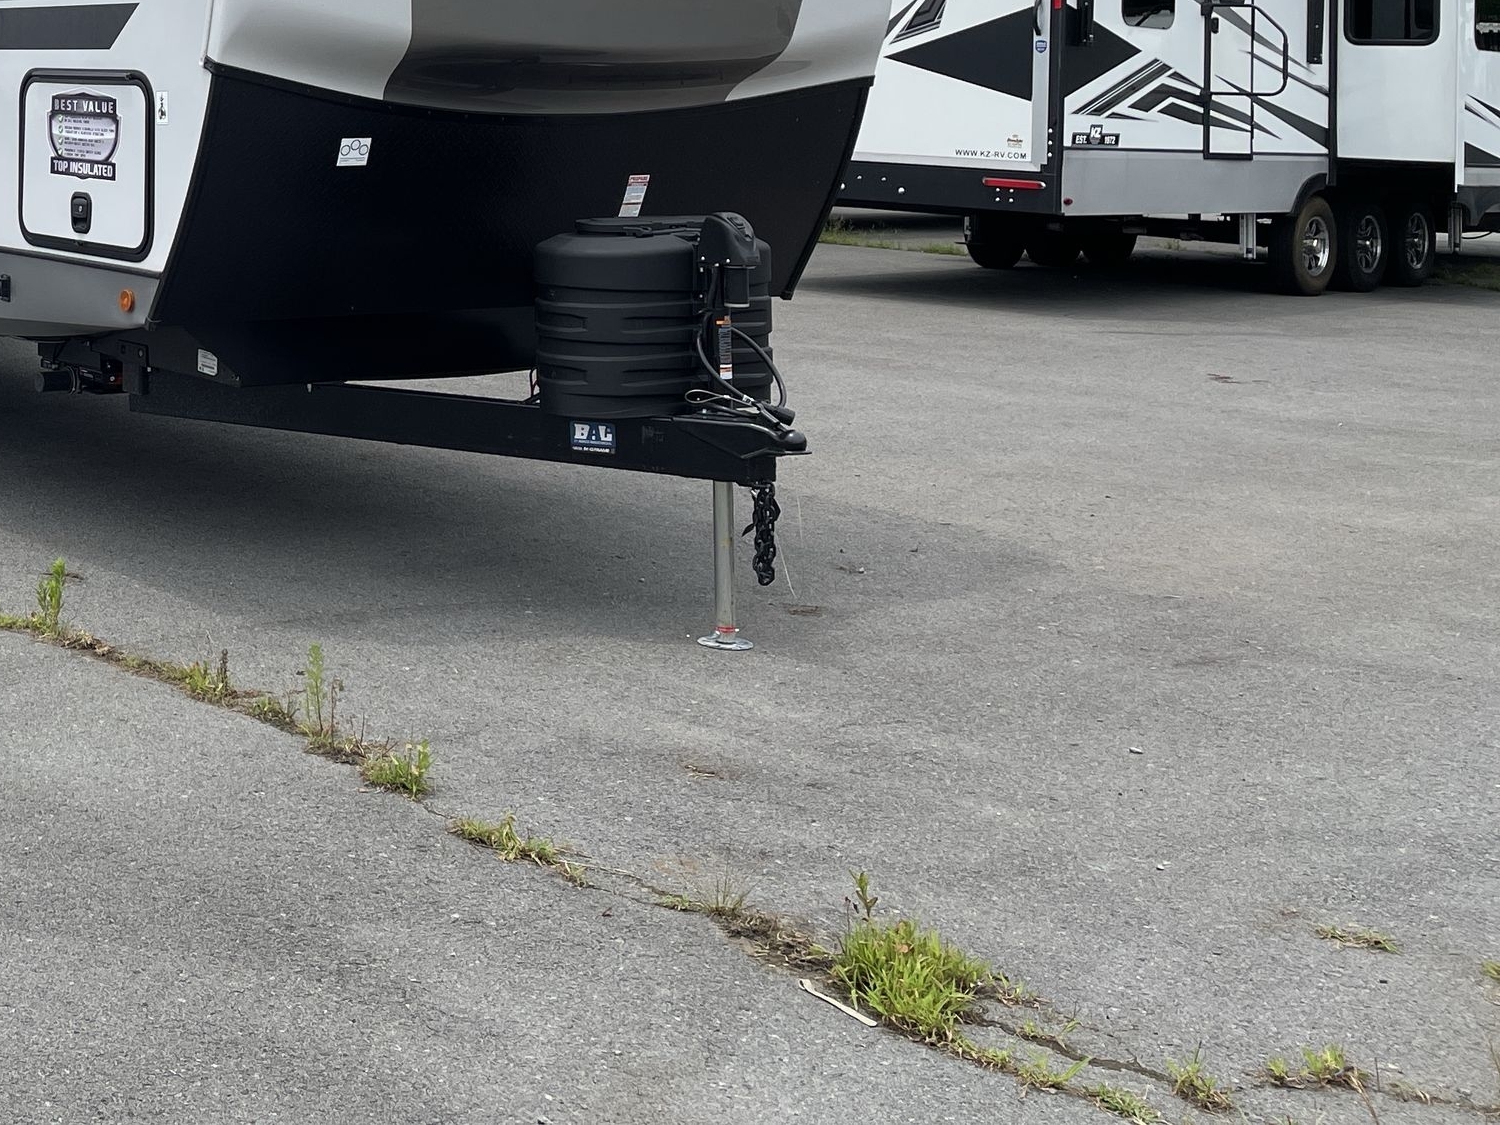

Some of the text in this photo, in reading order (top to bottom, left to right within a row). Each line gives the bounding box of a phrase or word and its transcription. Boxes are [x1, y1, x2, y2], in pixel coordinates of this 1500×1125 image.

[54, 98, 114, 114] BEST VALUE
[955, 148, 1027, 160] WWW.KZ-RV.COM
[53, 159, 113, 177] TOP INSULATED
